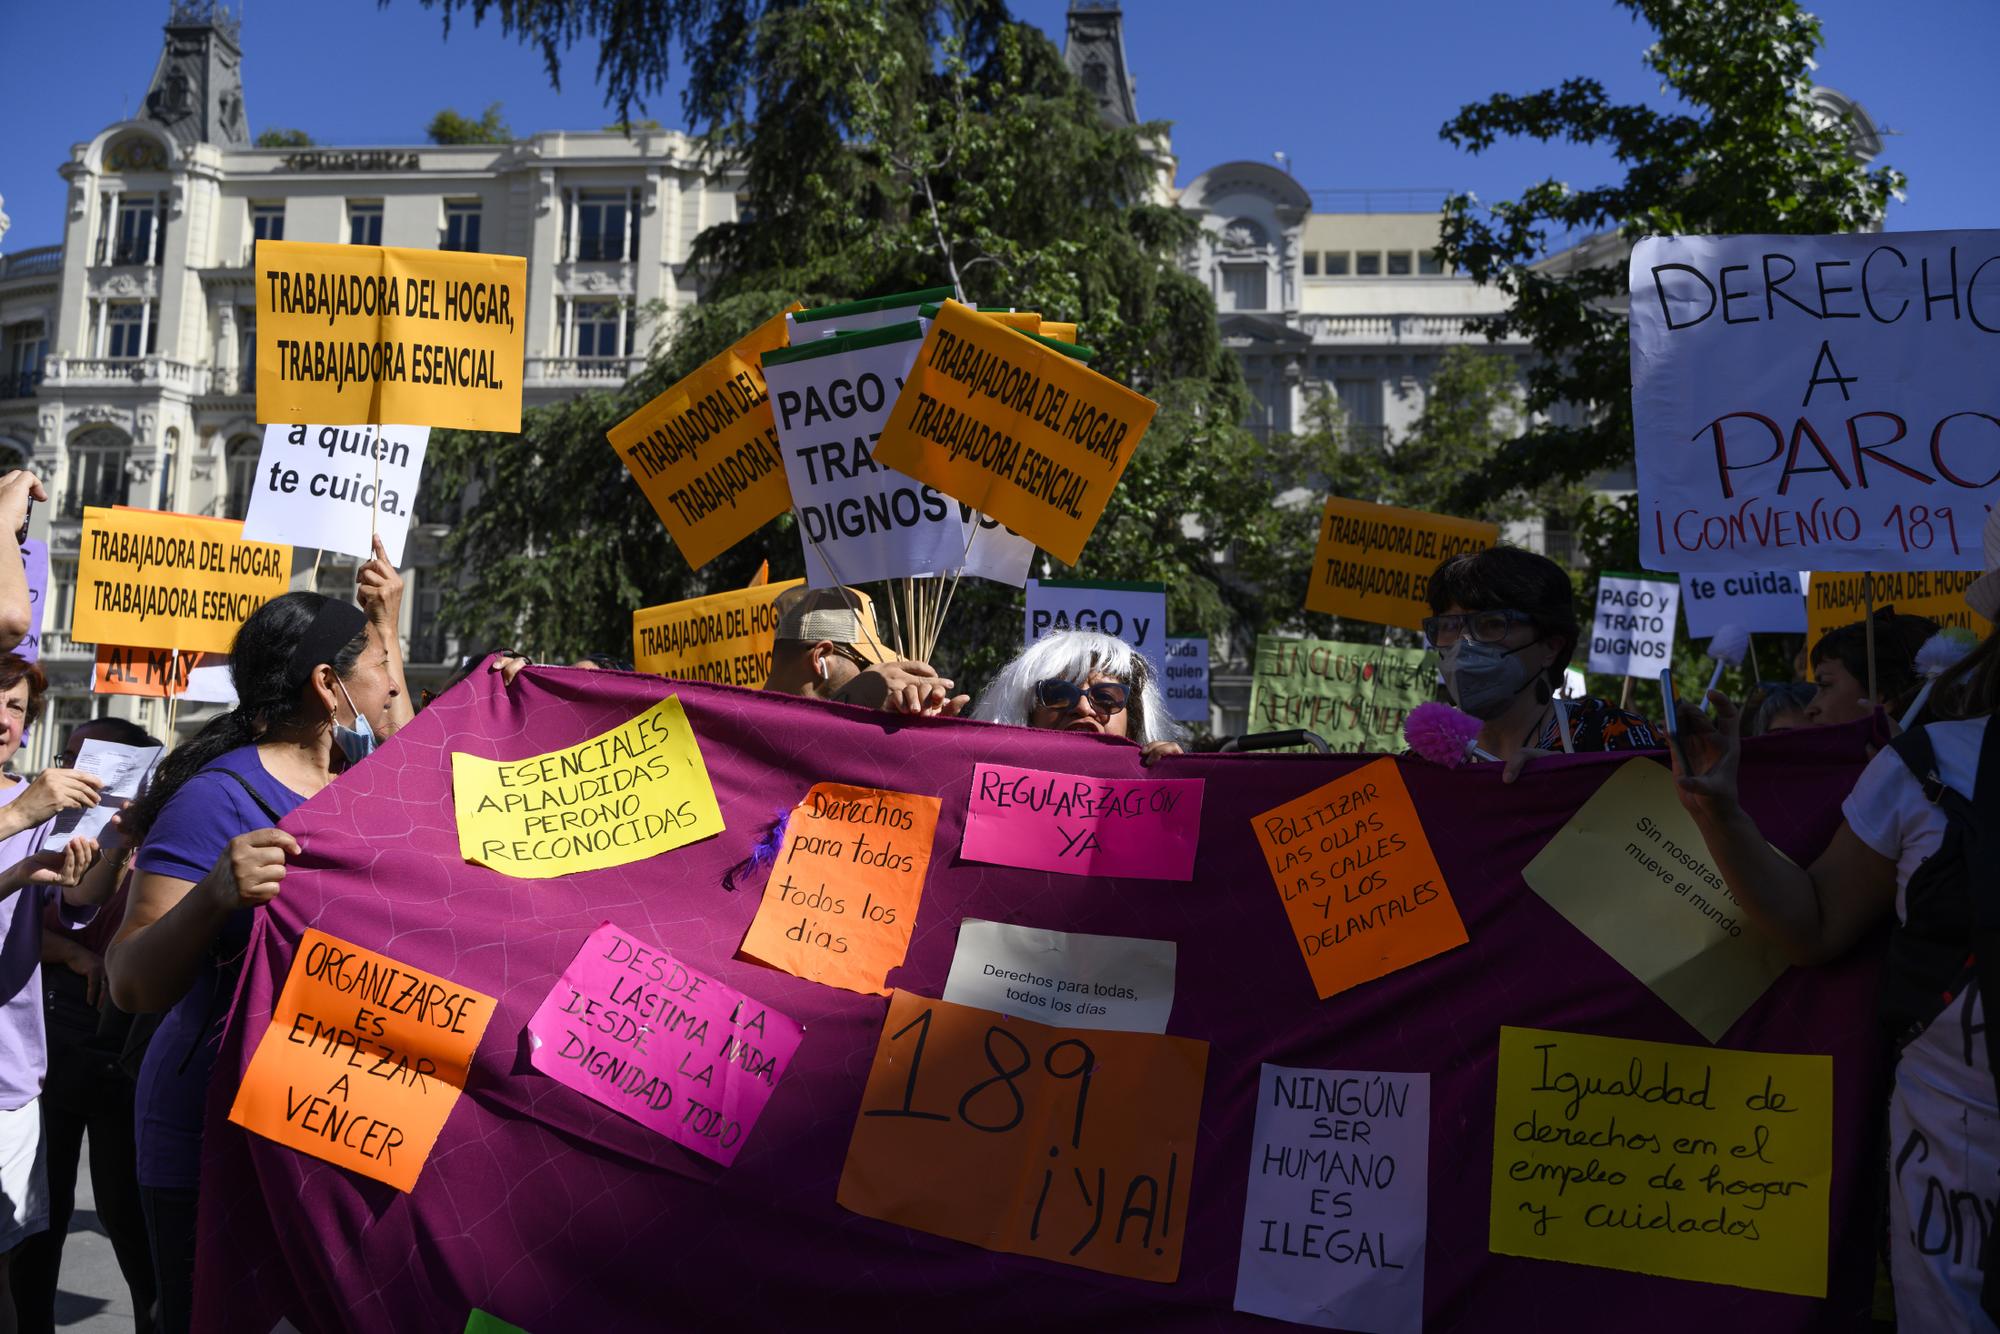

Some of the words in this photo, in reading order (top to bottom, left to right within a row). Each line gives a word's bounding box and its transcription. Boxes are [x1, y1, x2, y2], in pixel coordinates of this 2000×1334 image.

[267, 271, 400, 326] TRABAJADORA
[405, 278, 439, 319] DEL
[444, 281, 514, 334] HOGAR,
[277, 340, 406, 393] TRABAJADORA
[412, 344, 503, 390] ESENCIAL.
[1801, 340, 1859, 407] A
[627, 389, 740, 479] TRABAJADORA
[726, 371, 769, 414] DEL
[777, 372, 885, 430] PAGO
[928, 328, 1041, 416] TRABAJADORA
[1033, 383, 1070, 433] DEL
[1062, 399, 1128, 472] HOGAR,
[288, 424, 307, 445] a
[318, 425, 410, 468] quien
[797, 432, 891, 485] TRA
[908, 392, 1021, 480] TRABAJADORA
[1013, 448, 1088, 521] ESENCIAL.
[1691, 411, 2000, 499] PARO
[269, 461, 299, 493] te
[309, 471, 406, 516] cuida.
[668, 437, 779, 527] TRABAJADORA
[802, 484, 947, 544] DIGNOS
[1328, 515, 1412, 555] TRABAJADORA
[1414, 529, 1437, 560] DEL
[1884, 504, 1960, 556] 189
[91, 529, 195, 573] TRABAJADORA
[199, 542, 225, 573] DEL
[229, 546, 283, 584] HOGAR,
[1325, 559, 1409, 599] TRABAJADORA
[94, 580, 197, 622] TRABAJADORA
[1601, 589, 1654, 608] PAGO
[1658, 598, 1669, 613] y
[1690, 577, 1715, 599] te
[1723, 572, 1799, 597] cuida.
[1815, 572, 1903, 612] TRABAJADORA
[1907, 571, 1931, 599] DEL
[640, 613, 724, 658] TRABAJADORA
[726, 608, 749, 640] DEL
[751, 602, 780, 634] HOG
[1032, 609, 1123, 639] PAGO
[1133, 618, 1150, 646] y
[1593, 638, 1666, 658] DIGNOS
[1603, 613, 1664, 633] TRATO
[105, 648, 138, 683] AL
[734, 651, 773, 686] ESENC
[1166, 665, 1203, 679] quien
[1167, 686, 1207, 699] cuida.
[498, 712, 668, 788] ESENCIALES
[477, 755, 670, 813] APLAUDIDAS
[980, 771, 1184, 819] REGULARIZACIÓN
[482, 801, 697, 860] RECONOCIDAS
[807, 792, 913, 830] Derechos
[1264, 783, 1379, 845] POLITIZAR
[787, 834, 842, 864] para
[1057, 826, 1102, 857] YA
[1275, 845, 1312, 874] LAS
[1320, 812, 1384, 852] OLLAS
[1284, 870, 1326, 901] LAS
[1330, 833, 1407, 879] CALLES
[1636, 817, 1662, 842] Sin
[1662, 840, 1724, 890] nosotras
[779, 875, 845, 914] todos
[861, 893, 896, 924] los
[1312, 896, 1331, 919] Y
[1344, 870, 1387, 903] LOS
[1625, 842, 1674, 884] mueve
[1674, 882, 1693, 897] el
[1689, 893, 1741, 937] mundo
[1303, 880, 1439, 956] DELANTALES
[305, 941, 476, 1034] ORGANIZARSE
[602, 935, 707, 1003] DESDE
[729, 1000, 766, 1039] LA
[983, 964, 1053, 988] Derechos
[1057, 980, 1089, 994] para
[1094, 982, 1138, 1001] todas,
[1006, 987, 1046, 1007] todos
[1051, 997, 1072, 1013] los
[1076, 1002, 1107, 1015] días
[354, 1008, 387, 1037] ES
[559, 990, 656, 1056] DESDE
[677, 1051, 714, 1089] LA
[288, 1013, 436, 1095] EMPEZAR
[864, 1007, 1096, 1149] 189
[327, 1074, 349, 1102] A
[558, 1031, 672, 1111] DIGNIDAD
[681, 1098, 741, 1149] TODO
[1274, 1075, 1409, 1118] NINGÚN
[1531, 1043, 1716, 1120] Igualdad
[1746, 1075, 1799, 1113] de
[287, 1086, 404, 1167] VENCER
[1309, 1116, 1372, 1145] SER
[1513, 1109, 1661, 1154] derechos
[1730, 1125, 1773, 1164] el
[1262, 1143, 1396, 1190] HUMANO
[1509, 1160, 1627, 1196] empleo
[1648, 1163, 1686, 1191] de
[1700, 1165, 1808, 1210] hogar
[1310, 1189, 1353, 1217] ES
[1519, 1202, 1561, 1236] y
[1259, 1220, 1404, 1270] ILEGAL
